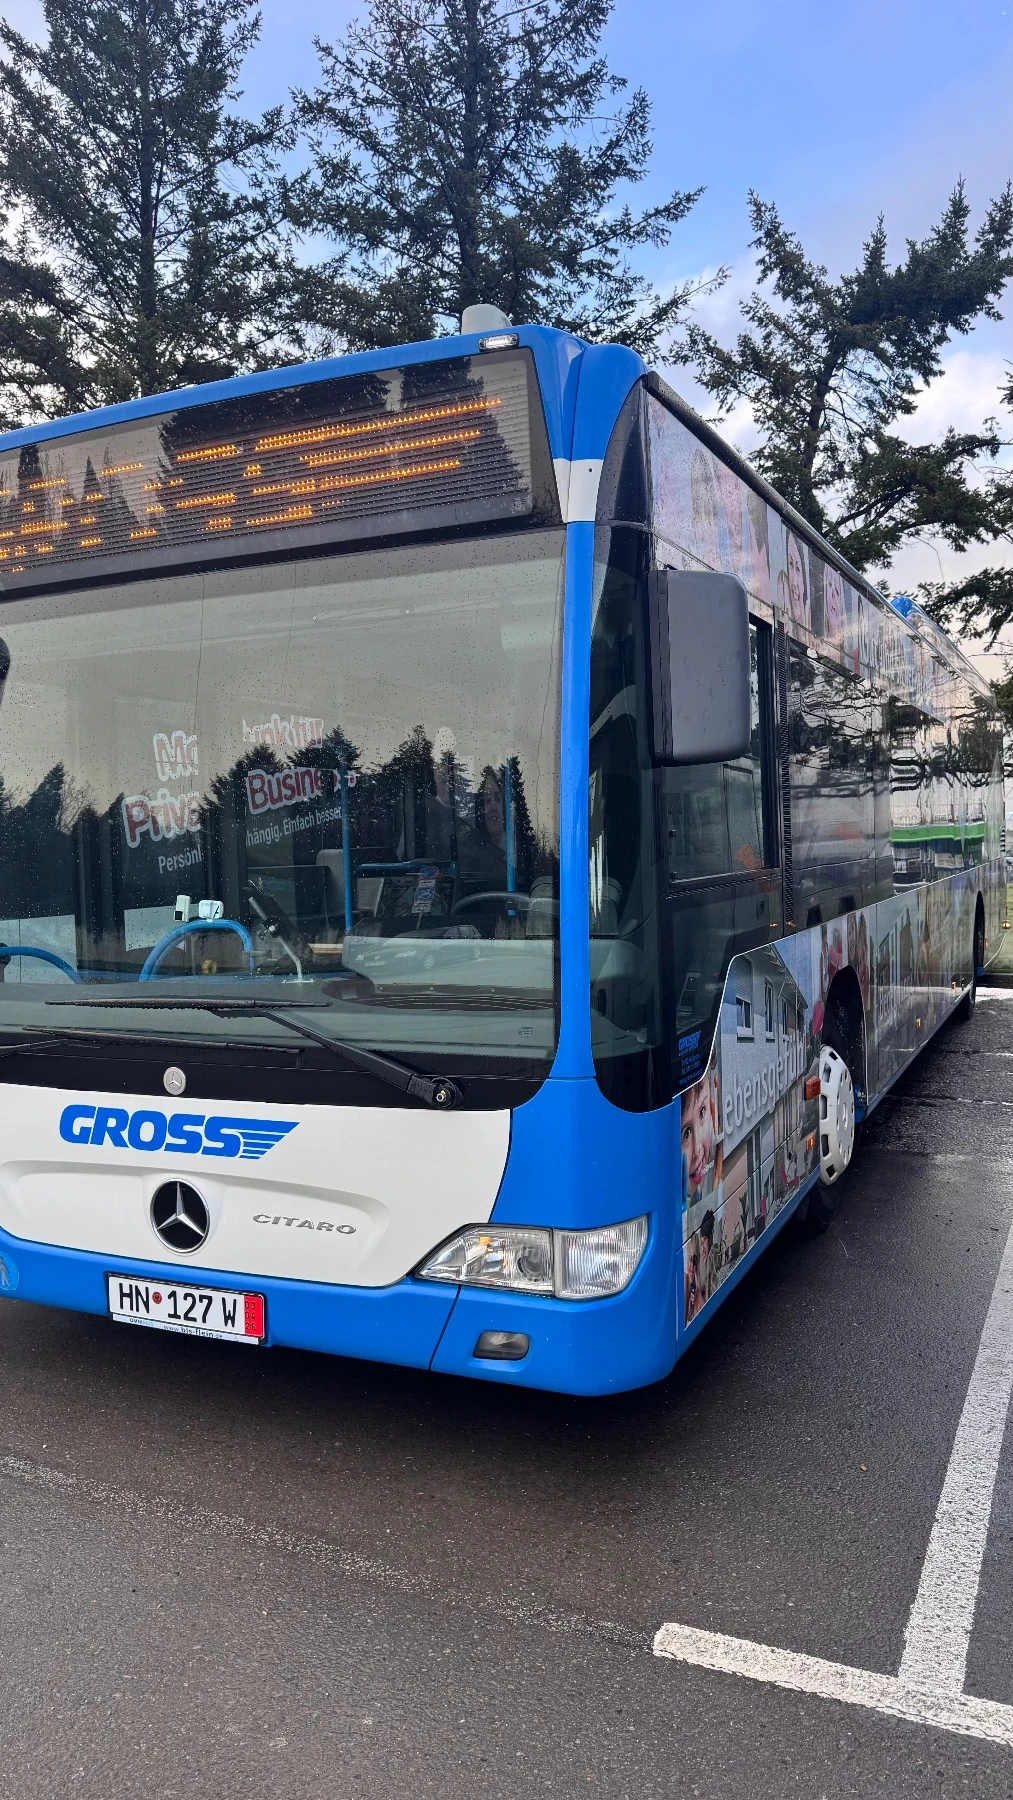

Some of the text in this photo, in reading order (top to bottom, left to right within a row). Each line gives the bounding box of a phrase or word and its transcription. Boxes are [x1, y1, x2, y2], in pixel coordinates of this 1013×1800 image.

[283, 811, 315, 835] Einfach
[59, 1104, 300, 1160] GROSS
[252, 1214, 357, 1235] CITARO
[118, 1282, 237, 1328] HN 127 W
[244, 1301, 256, 1310] 03
[244, 1312, 256, 1321] 04
[244, 1322, 256, 1331] 26
